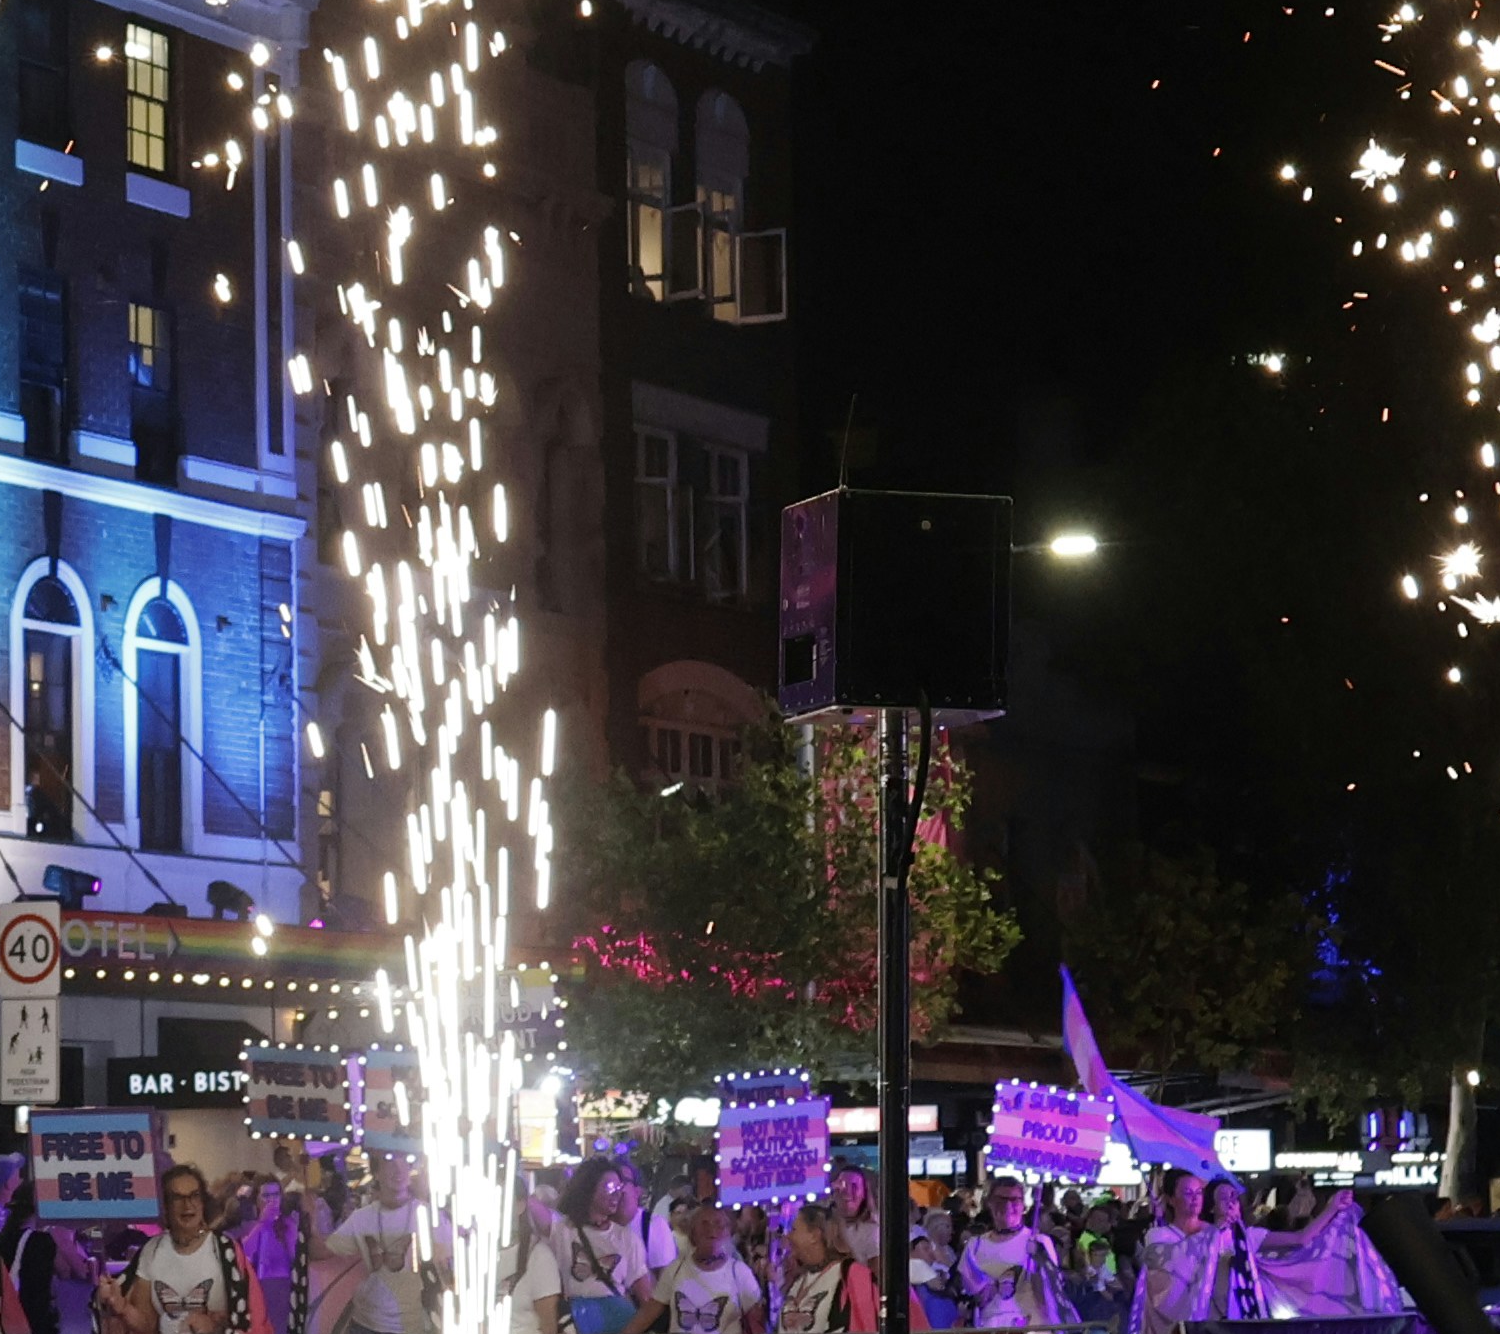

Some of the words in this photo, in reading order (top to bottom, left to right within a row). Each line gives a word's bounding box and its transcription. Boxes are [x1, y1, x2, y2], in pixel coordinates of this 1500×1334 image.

[8, 934, 50, 964] 40
[60, 917, 156, 960] OTEL
[129, 1072, 174, 1095] BAR
[41, 1131, 106, 1162] FREE
[107, 1130, 145, 1160] TO
[1022, 1119, 1078, 1145] PROUD
[58, 1172, 92, 1202] BE
[96, 1171, 135, 1201] ME
